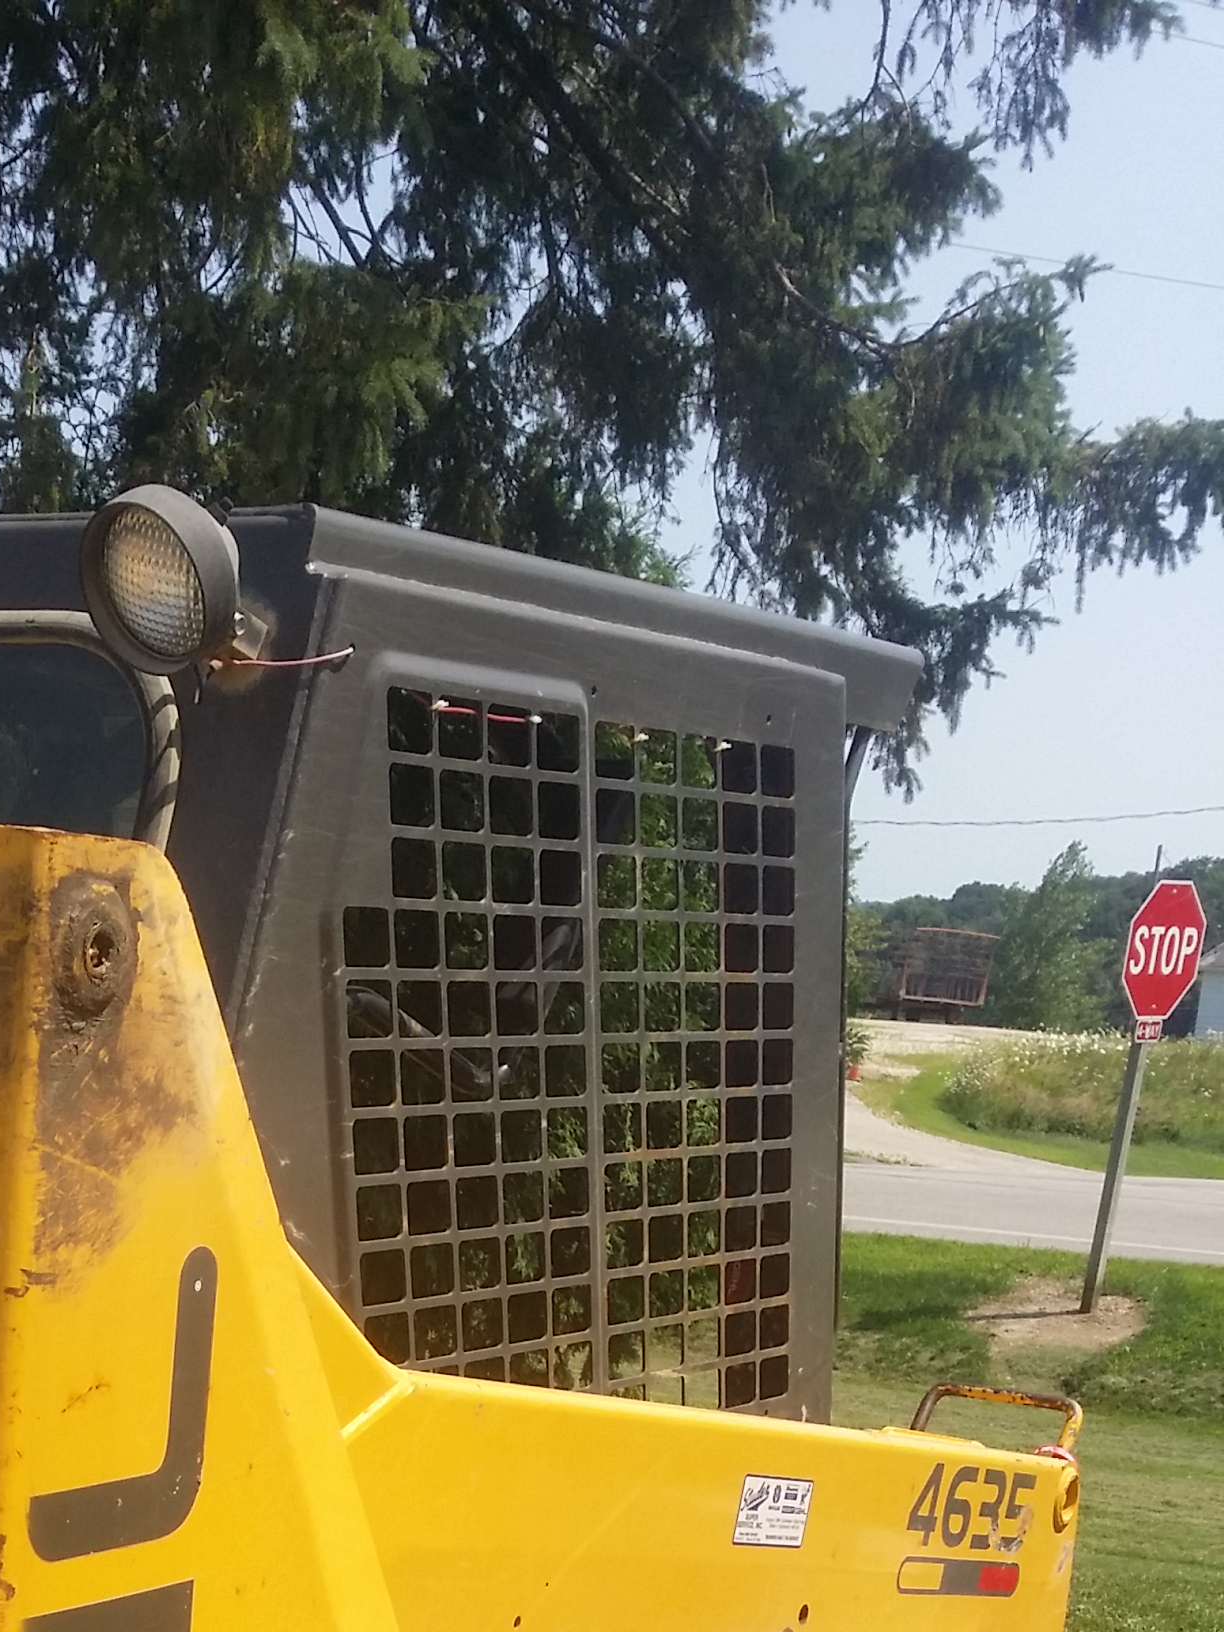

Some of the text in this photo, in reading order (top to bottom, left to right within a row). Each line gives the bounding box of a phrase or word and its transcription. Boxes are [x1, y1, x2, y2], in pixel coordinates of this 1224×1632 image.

[1129, 925, 1198, 976] STOP
[1137, 1022, 1160, 1039] 4-WAY
[906, 1462, 1037, 1551] 4635
